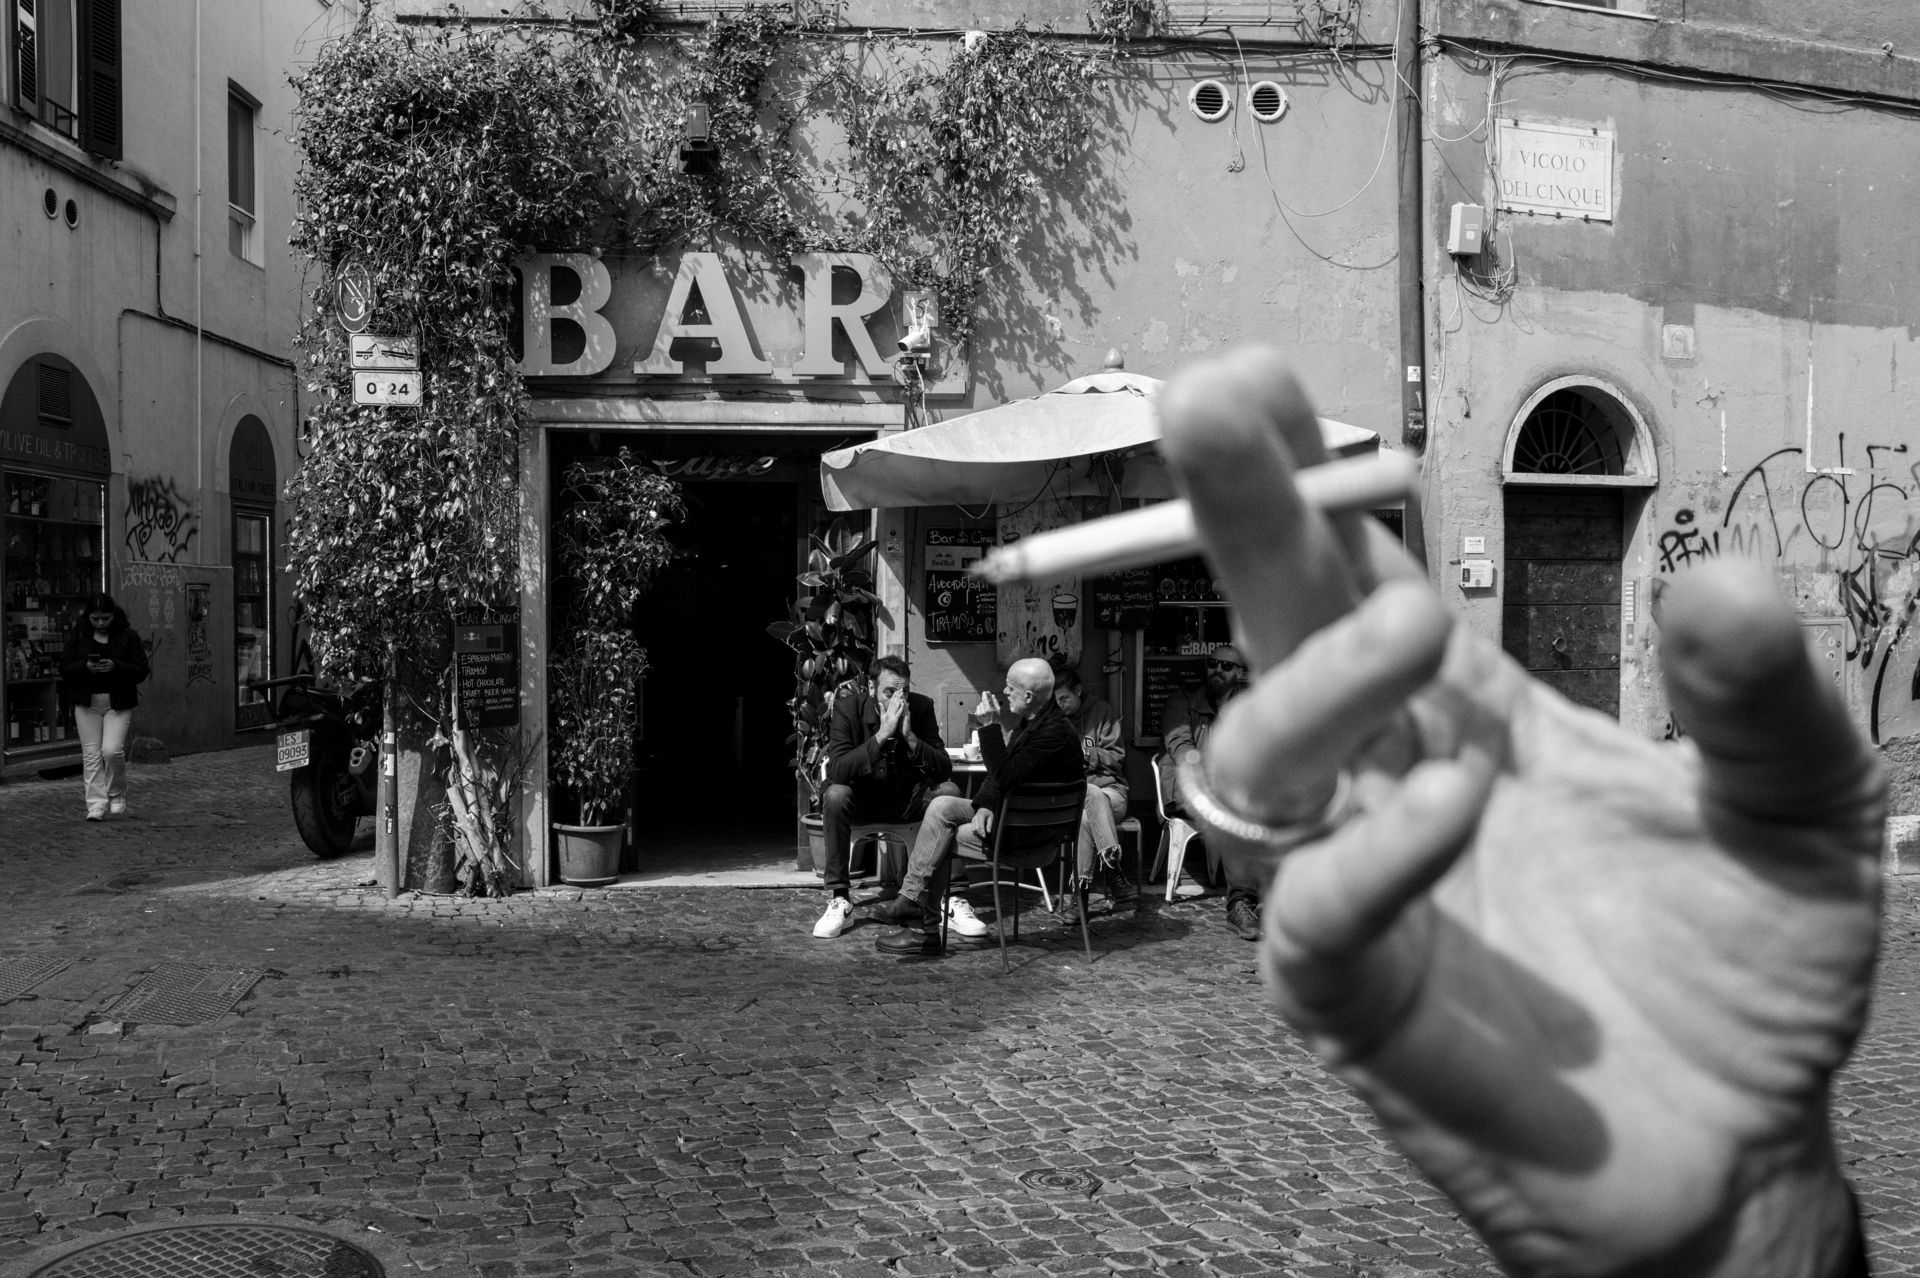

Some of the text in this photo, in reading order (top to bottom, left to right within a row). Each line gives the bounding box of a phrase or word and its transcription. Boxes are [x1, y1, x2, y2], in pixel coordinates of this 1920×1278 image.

[1520, 150, 1586, 173] VICOLO
[1502, 179, 1603, 207] DEL CINQUE
[511, 251, 894, 377] BAR
[916, 297, 928, 319] 5
[0, 430, 33, 454] OLIVE
[35, 436, 52, 458] OIL
[928, 530, 956, 545] Bar
[284, 733, 297, 746] ES
[278, 744, 307, 762] 09093
